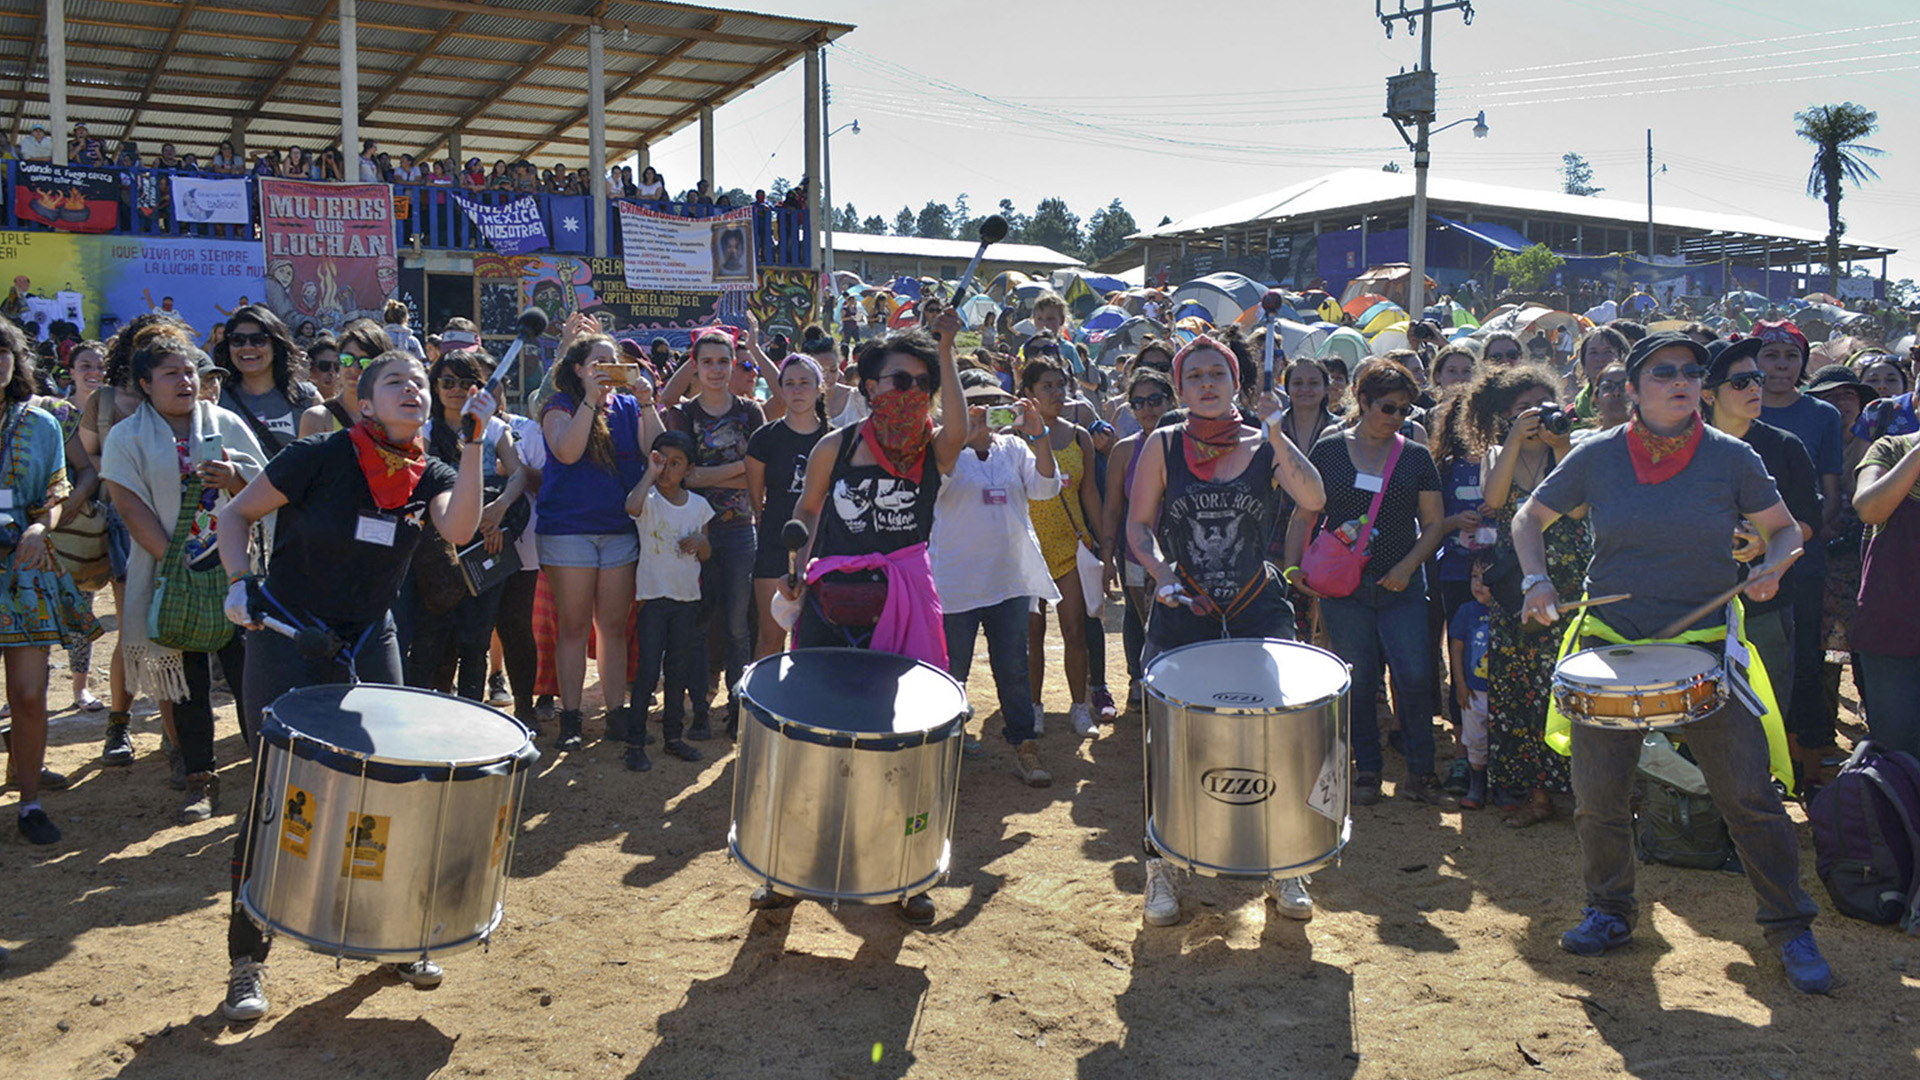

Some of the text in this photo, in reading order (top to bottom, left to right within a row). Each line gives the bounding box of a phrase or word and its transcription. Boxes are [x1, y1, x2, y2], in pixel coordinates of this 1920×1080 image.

[20, 162, 52, 174] Cuando
[268, 195, 387, 220] MUJERES
[315, 220, 344, 233] QUE
[270, 232, 387, 258] LUCHAN
[142, 248, 170, 260] VIVA
[174, 249, 195, 260] POR
[201, 250, 248, 262] SIEMPRE
[144, 262, 159, 274] LA
[162, 263, 198, 275] LUCHA
[201, 264, 215, 275] DE
[220, 264, 241, 276] LAS
[603, 292, 649, 304] CAPITALISMO
[1190, 492, 1231, 510] YORK
[1210, 776, 1268, 794] IZZO
